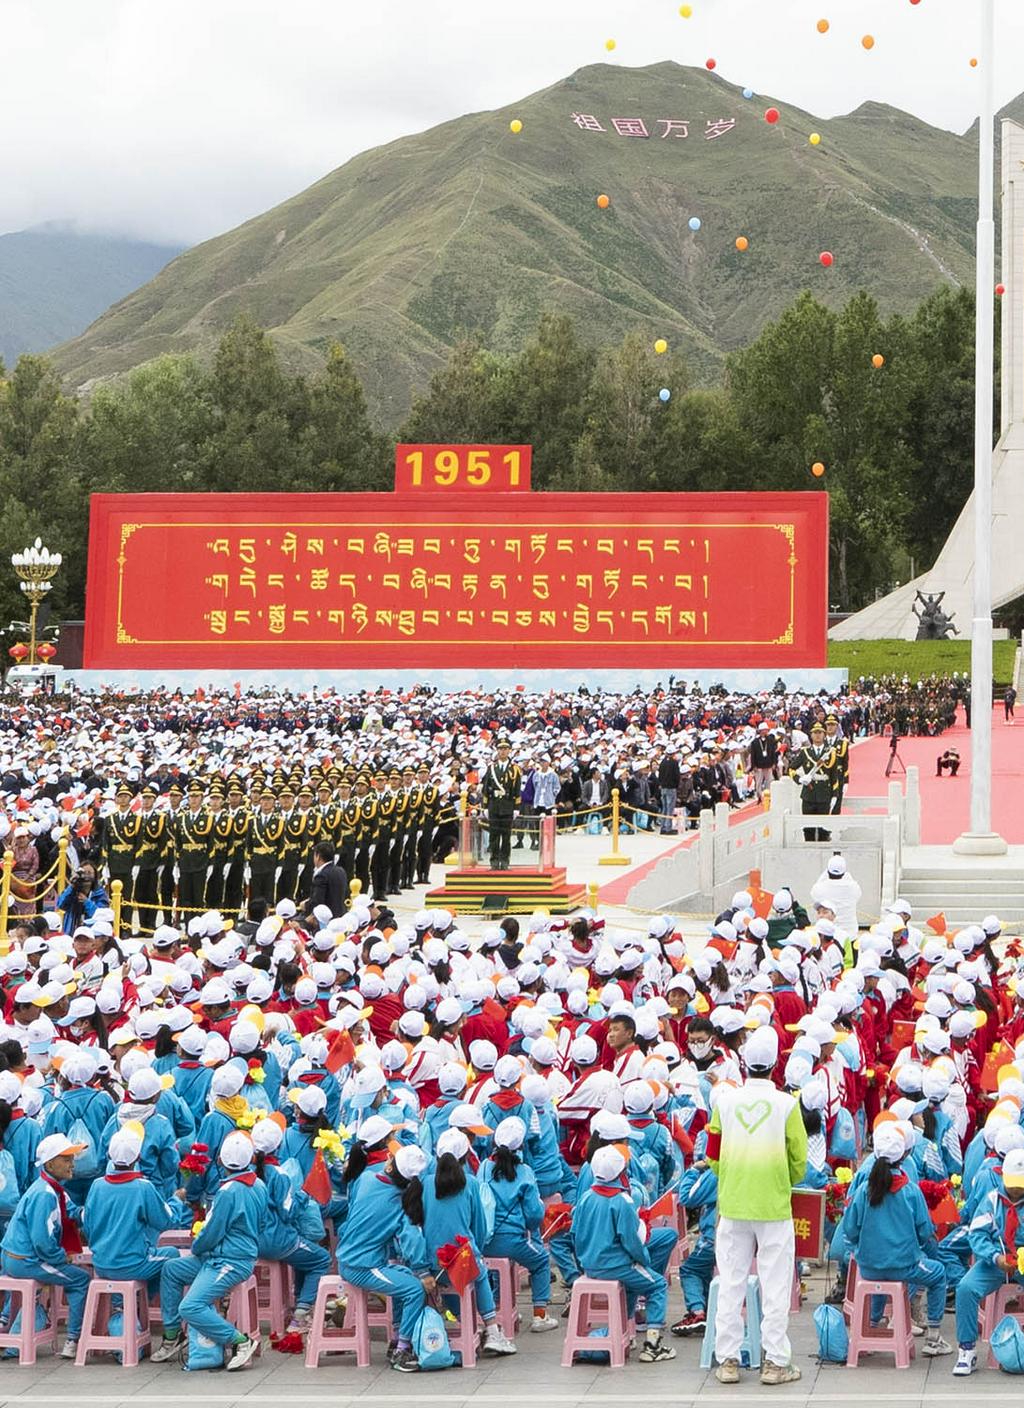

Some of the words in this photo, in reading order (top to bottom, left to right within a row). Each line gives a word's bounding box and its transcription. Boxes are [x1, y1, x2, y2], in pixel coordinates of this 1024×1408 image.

[569, 111, 736, 140] 祖国万岁
[405, 450, 521, 486] 1951
